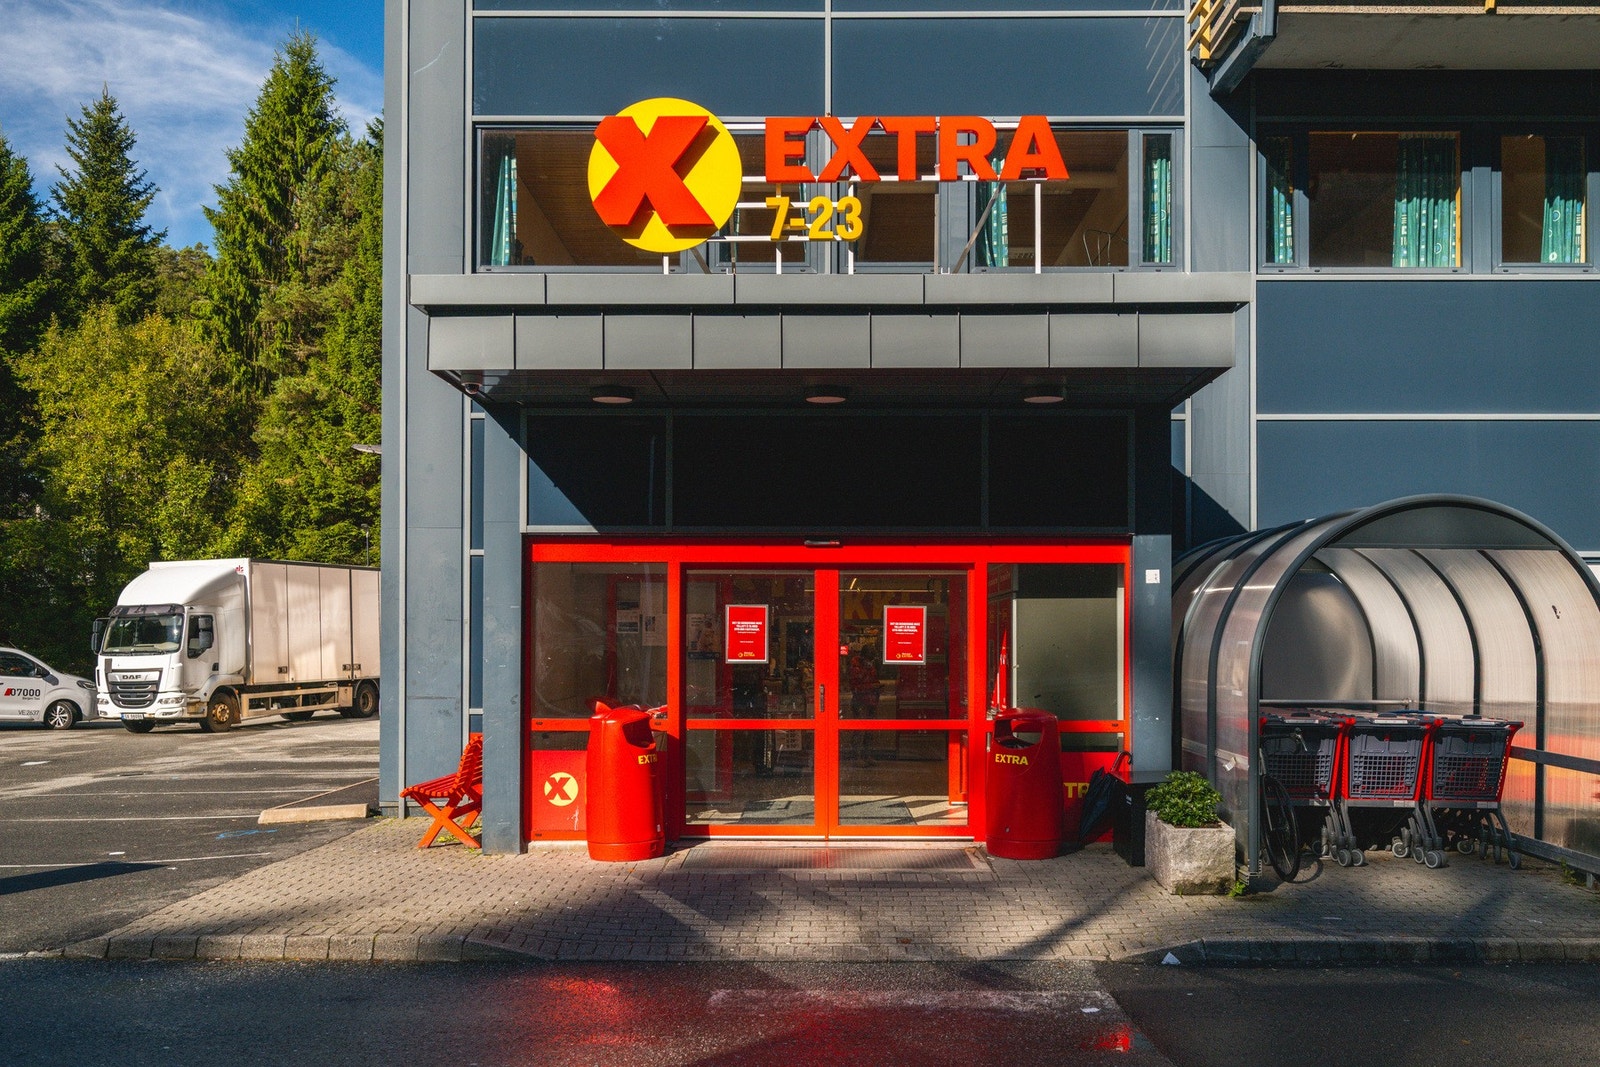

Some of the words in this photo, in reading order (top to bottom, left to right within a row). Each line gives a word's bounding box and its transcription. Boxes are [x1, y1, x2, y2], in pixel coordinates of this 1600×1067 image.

[592, 116, 715, 226] X
[765, 115, 1070, 183] EXTRA
[765, 195, 863, 242] 7-23
[10, 688, 41, 697] 07000
[637, 753, 658, 765] EXTR
[995, 753, 1029, 766] EXTRA
